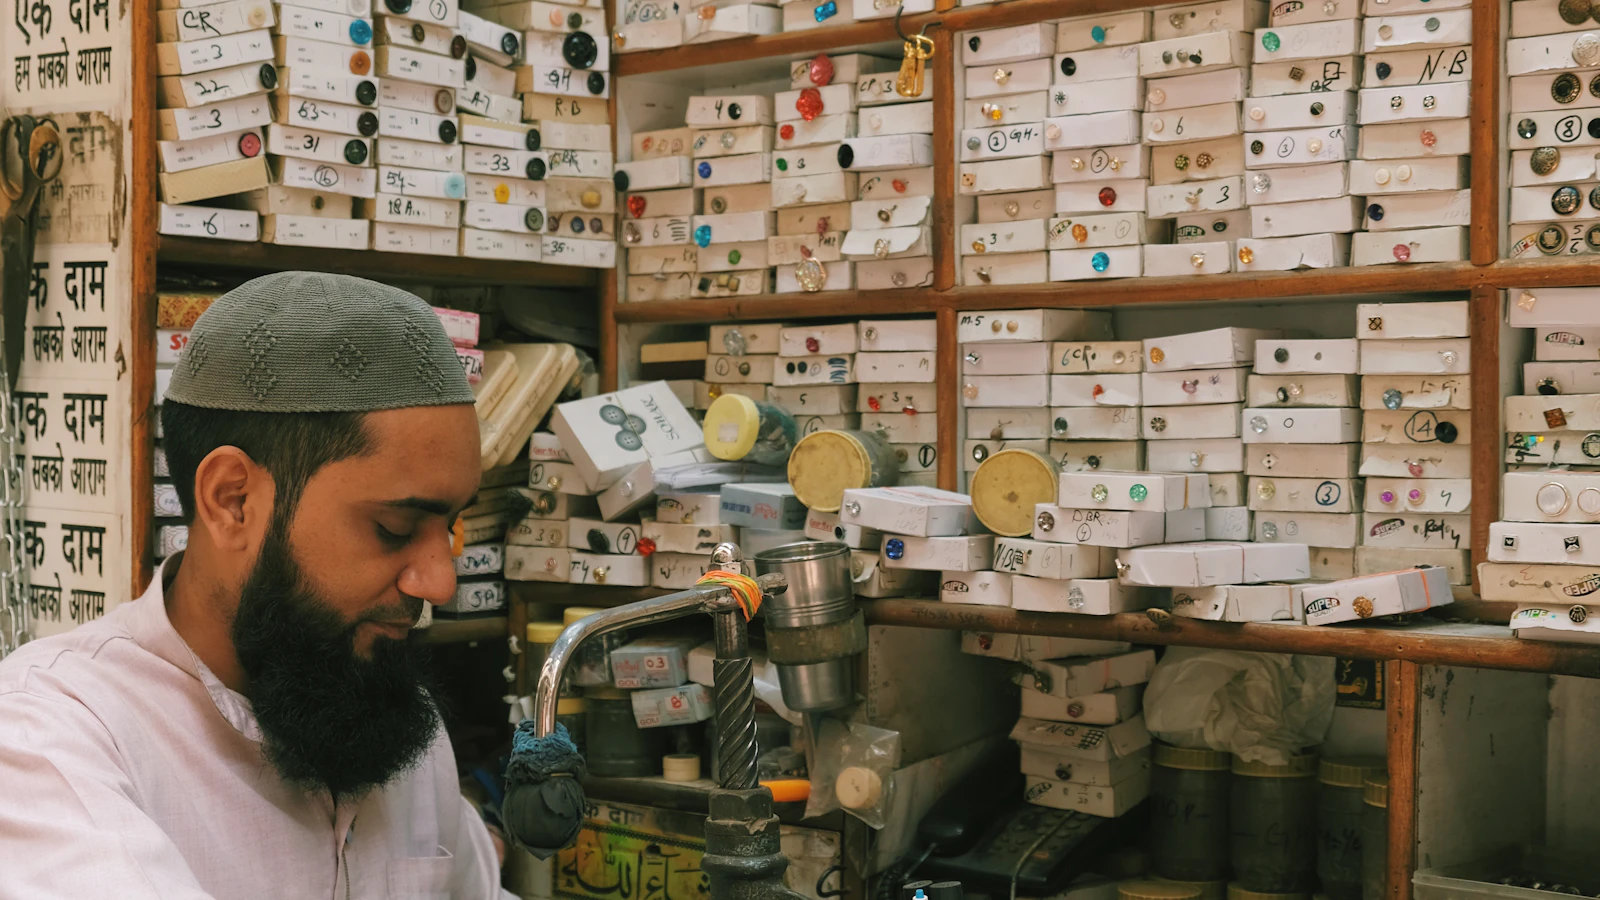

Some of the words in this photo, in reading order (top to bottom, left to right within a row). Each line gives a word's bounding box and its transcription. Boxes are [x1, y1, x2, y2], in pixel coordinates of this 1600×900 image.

[76, 46, 112, 86] आराम
[1176, 116, 1184, 135] 6
[489, 154, 511, 171] 33
[1216, 185, 1230, 204] 3
[652, 223, 660, 239] 6
[63, 261, 108, 312] दाम
[32, 311, 65, 363] सबको
[71, 326, 107, 363] आराम
[63, 393, 108, 445] दाम
[32, 442, 64, 493] सबको
[71, 458, 107, 496] आराम
[61, 523, 106, 578] दाम
[943, 581, 969, 593] SUPER
[1307, 597, 1341, 614] SUPER
